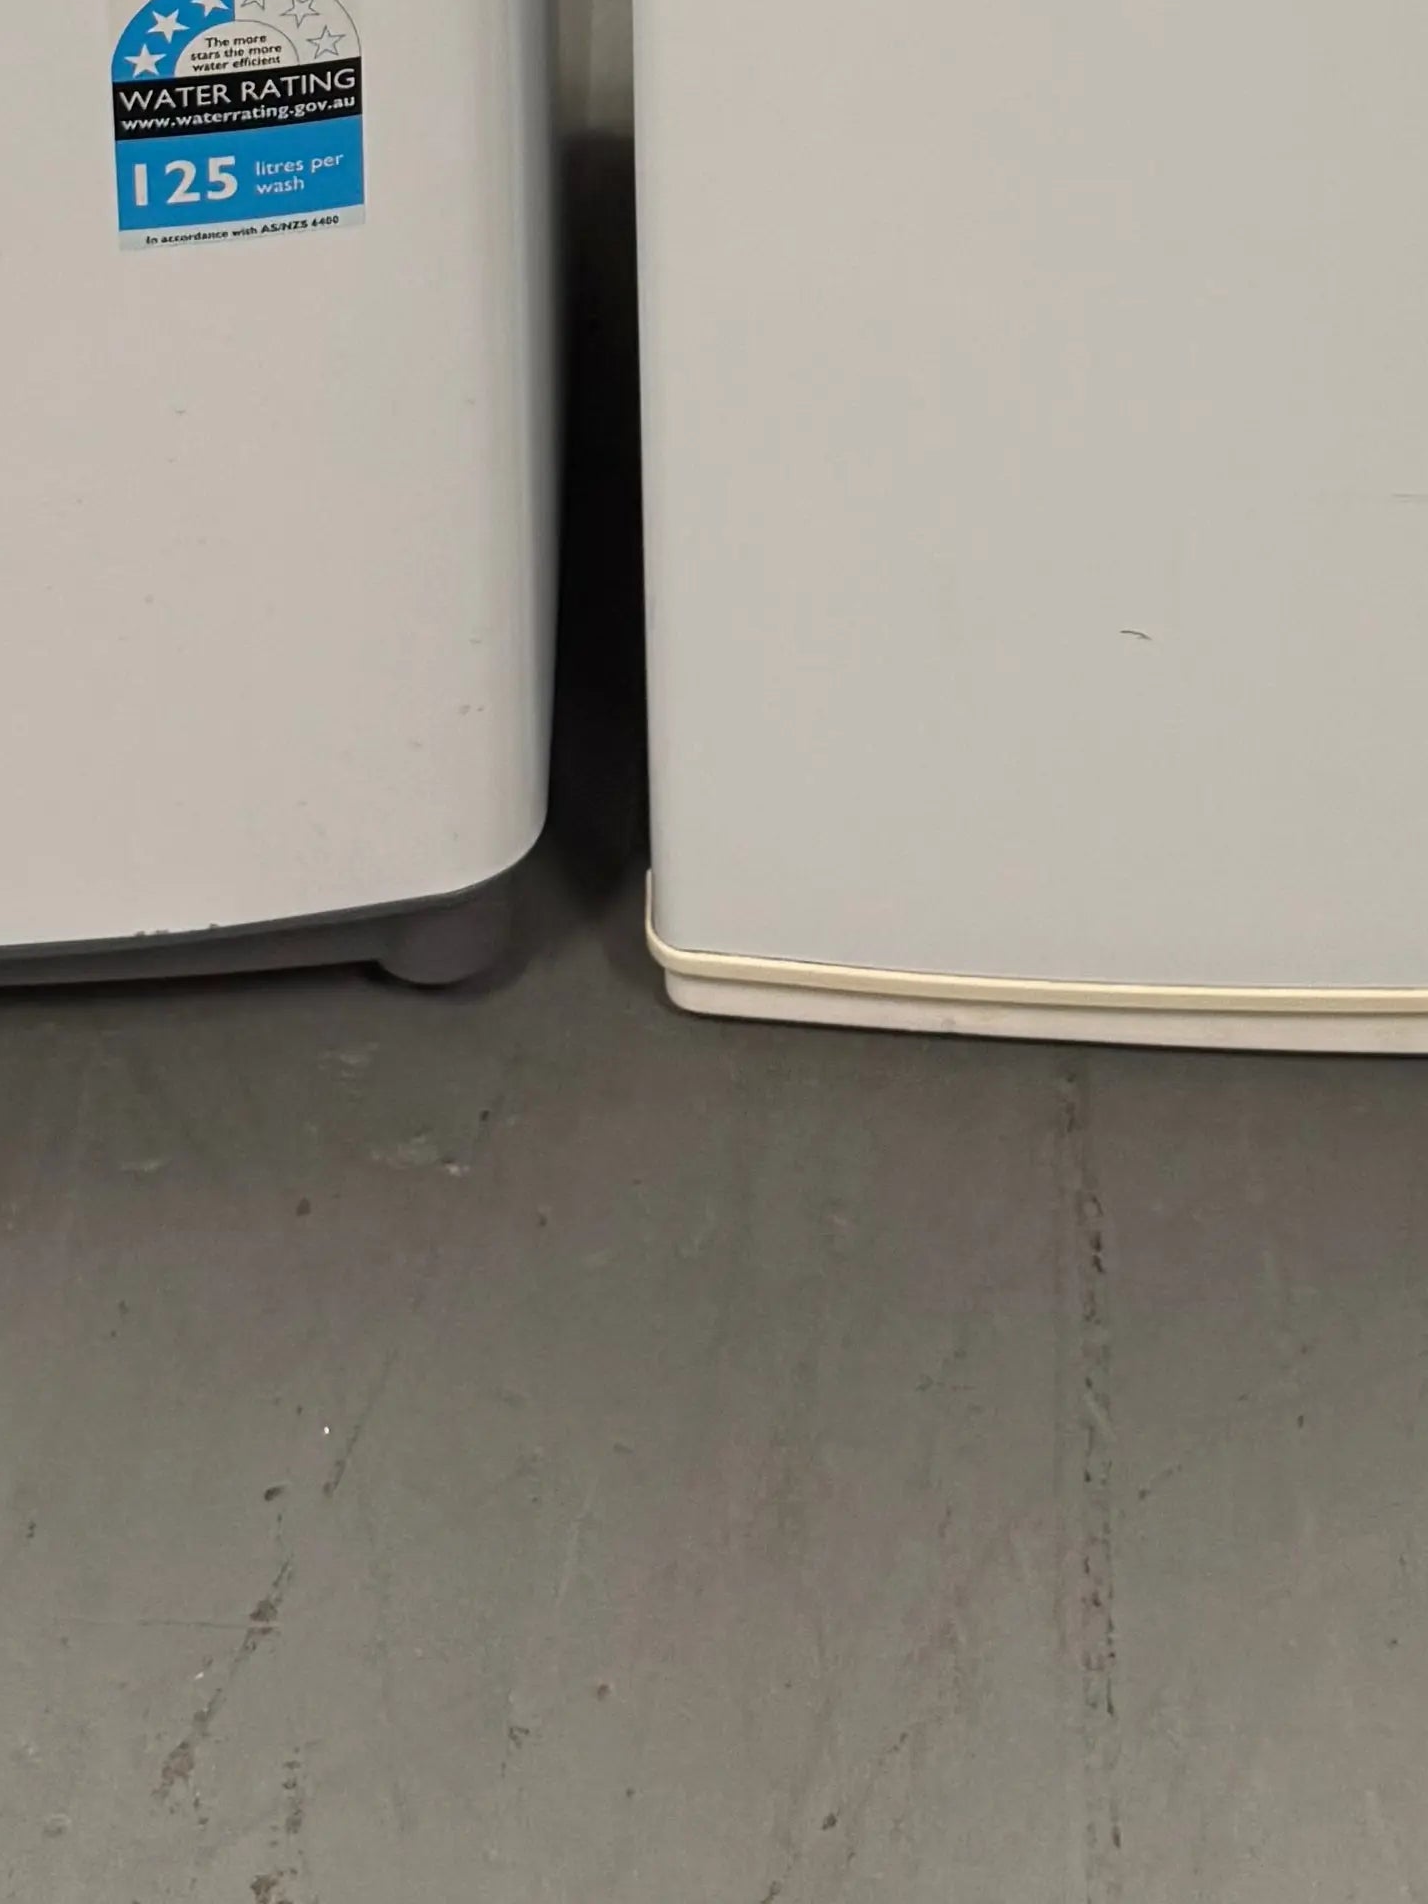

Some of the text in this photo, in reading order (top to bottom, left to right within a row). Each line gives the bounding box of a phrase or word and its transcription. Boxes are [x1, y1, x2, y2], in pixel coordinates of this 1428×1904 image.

[205, 35, 266, 47] The more
[191, 45, 282, 60] stars the more
[193, 56, 280, 72] water efficient
[119, 68, 356, 112] WATER RATING
[122, 97, 355, 130] www.waterrating.gov.au
[256, 154, 344, 176] litres per
[134, 155, 238, 206] 125
[257, 176, 305, 194] wash
